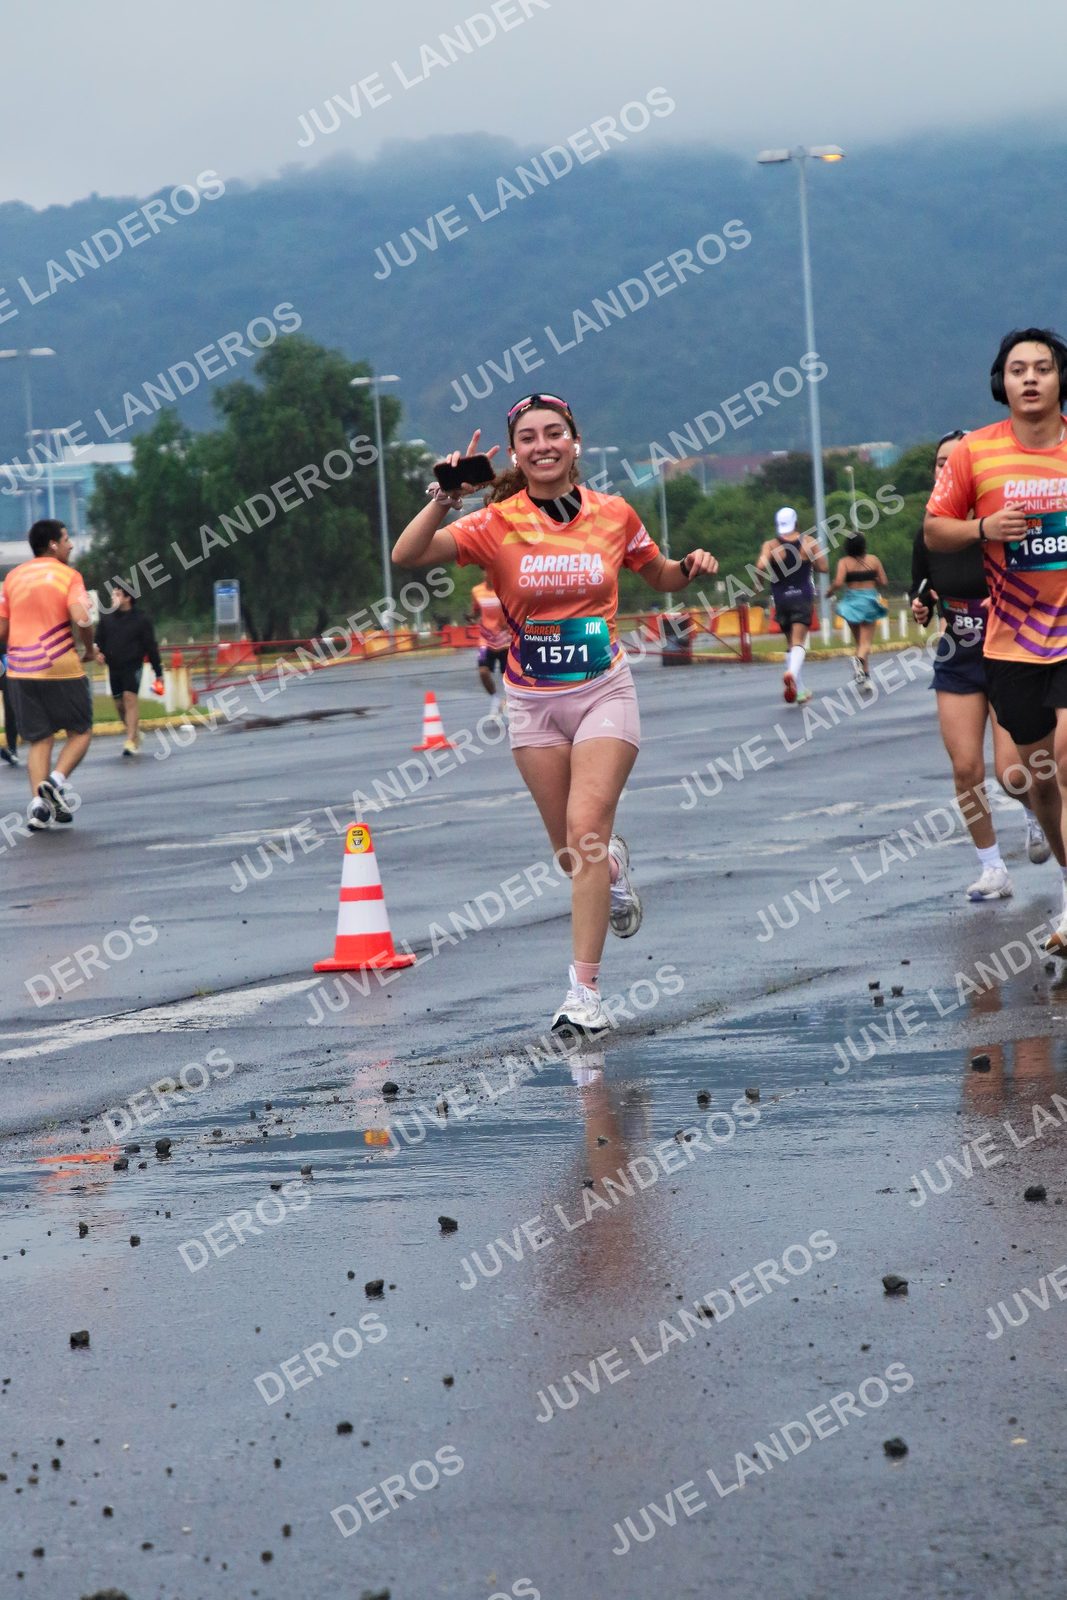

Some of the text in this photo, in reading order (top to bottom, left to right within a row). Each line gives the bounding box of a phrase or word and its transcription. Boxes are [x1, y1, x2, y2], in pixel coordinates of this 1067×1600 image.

[1019, 536, 1067, 556] 1688
[520, 553, 605, 573] CARRERA
[524, 621, 601, 636] CARRERA 10K
[536, 644, 589, 664] 1571
